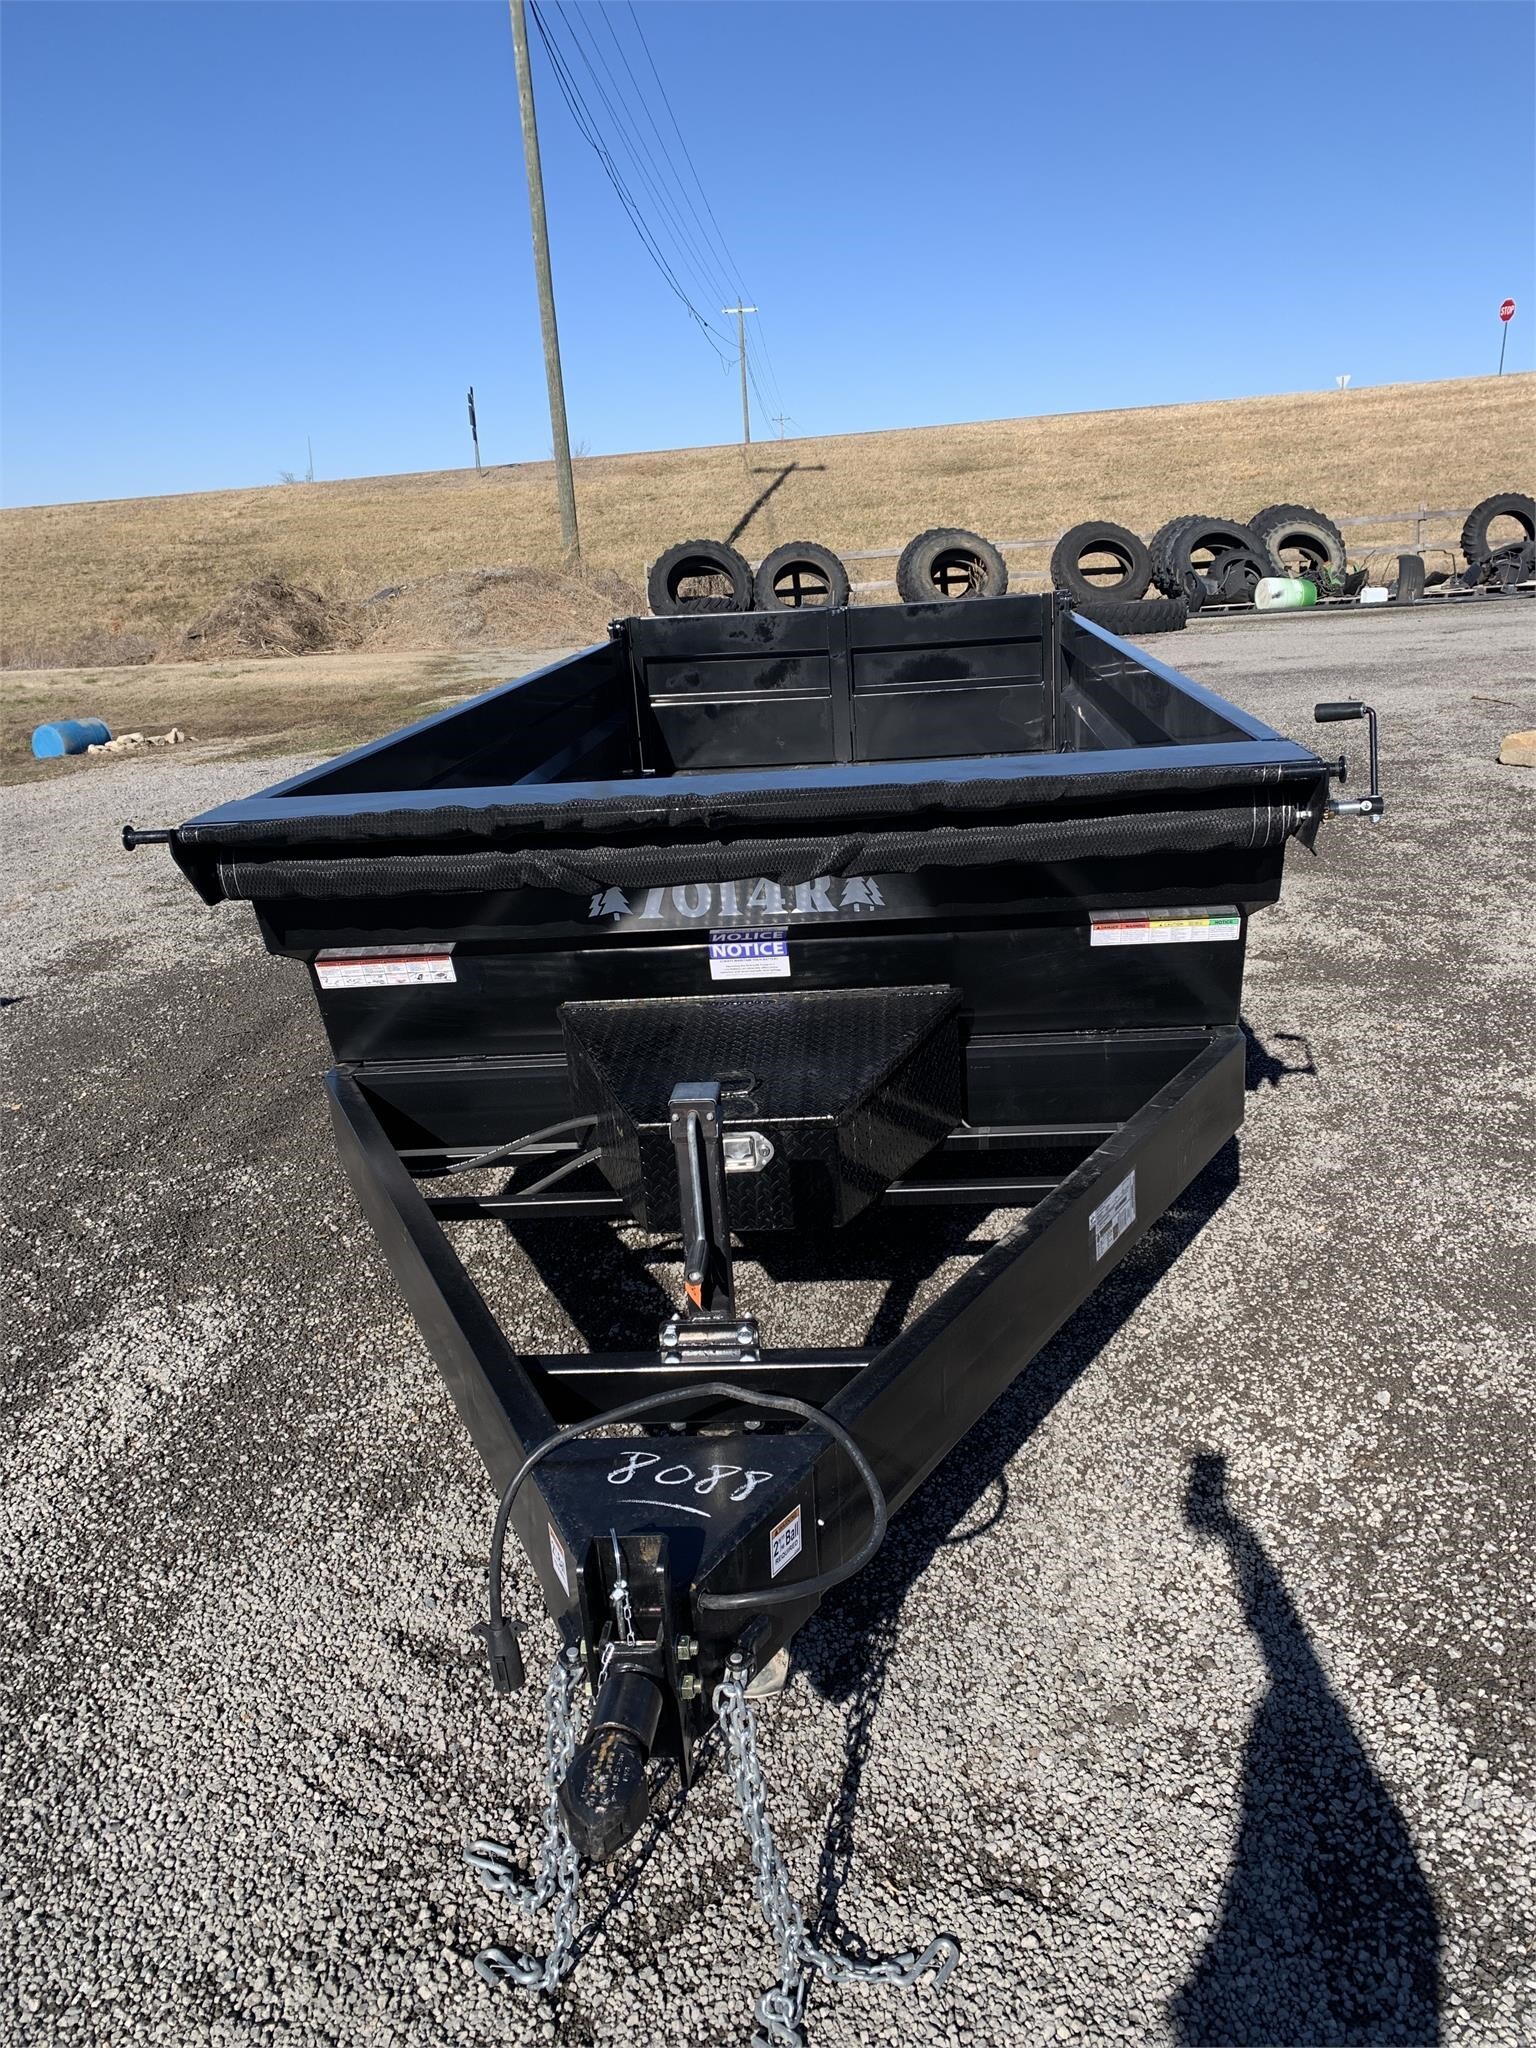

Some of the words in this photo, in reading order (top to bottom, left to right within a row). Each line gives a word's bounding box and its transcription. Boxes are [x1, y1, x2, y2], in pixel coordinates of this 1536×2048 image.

[1500, 305, 1515, 316] STOP
[712, 942, 785, 958] NOTICE
[607, 1452, 774, 1501] 8088
[785, 1521, 799, 1546] Ball
